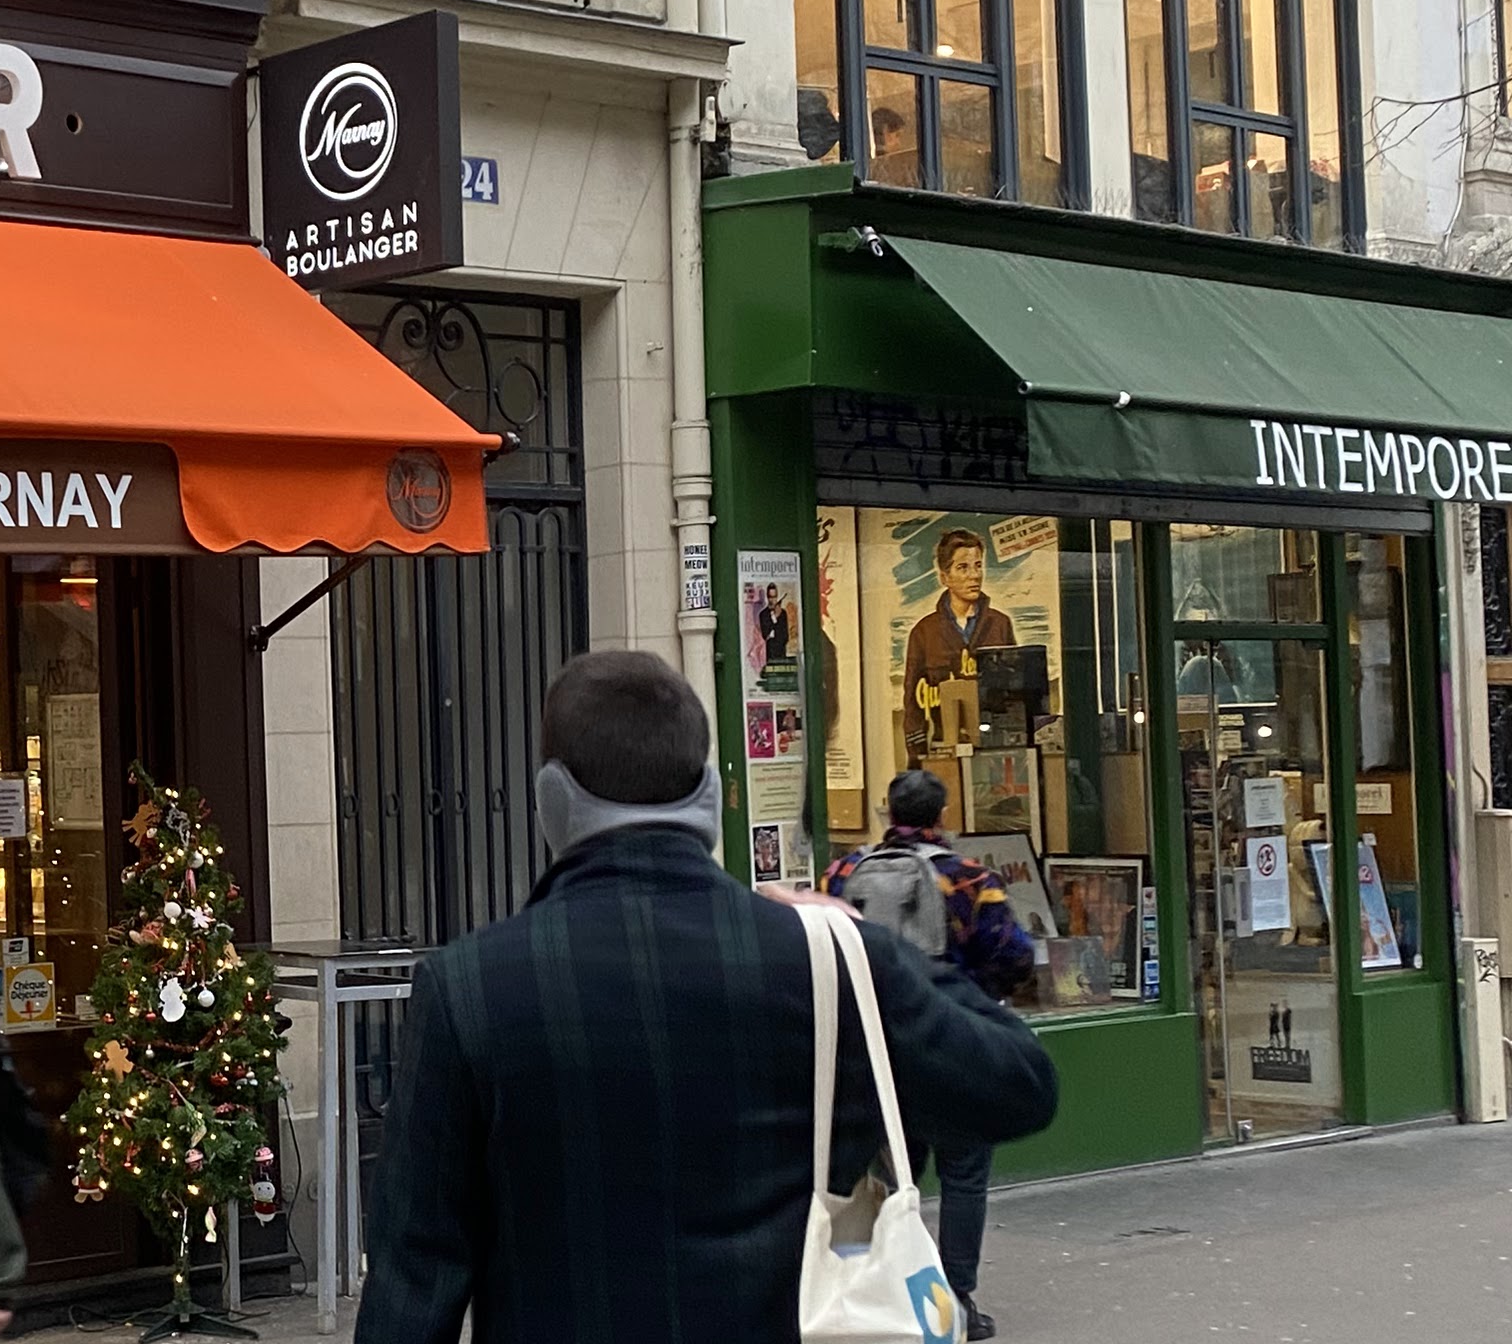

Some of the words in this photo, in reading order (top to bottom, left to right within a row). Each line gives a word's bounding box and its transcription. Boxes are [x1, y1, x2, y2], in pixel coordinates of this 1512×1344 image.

[307, 103, 386, 161] Marnay
[462, 159, 494, 200] 24
[286, 201, 418, 251] ARTISAN
[286, 230, 418, 277] BOULANGER
[1250, 419, 1512, 501] INTEMPORE
[740, 556, 798, 574] intemporel
